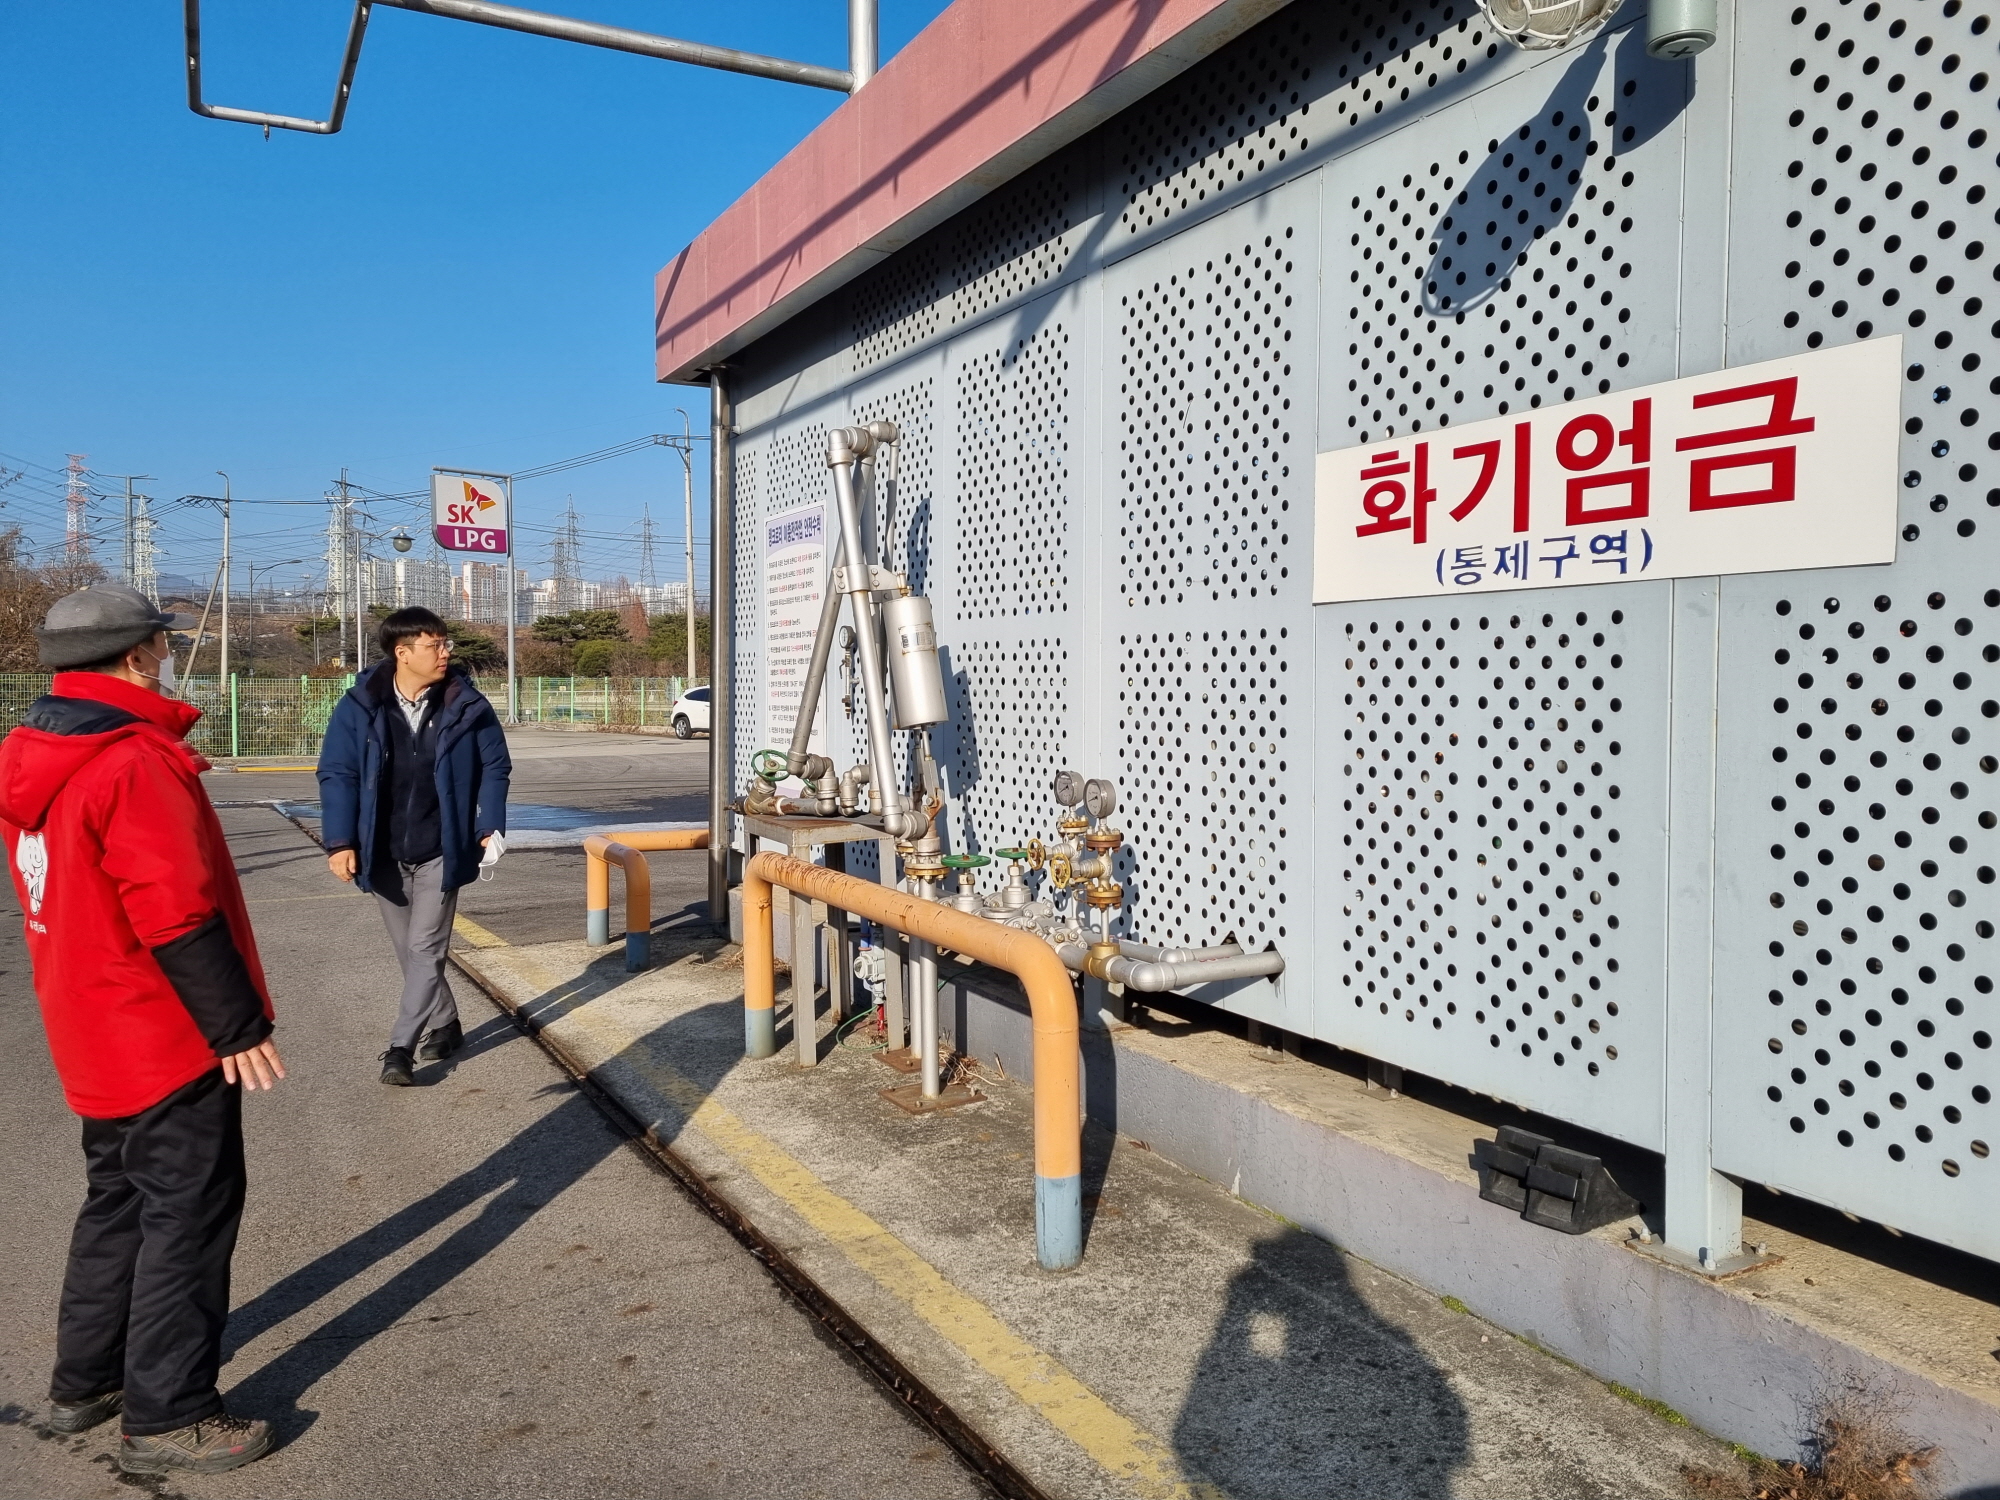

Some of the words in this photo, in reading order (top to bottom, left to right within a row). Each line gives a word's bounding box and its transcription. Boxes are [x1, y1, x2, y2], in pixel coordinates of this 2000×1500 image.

[1355, 376, 1815, 544] 화기엄금
[447, 504, 475, 524] SK
[804, 514, 822, 538] 안전수칙
[454, 528, 496, 550] LPG
[1435, 528, 1653, 587] (통제구역)
